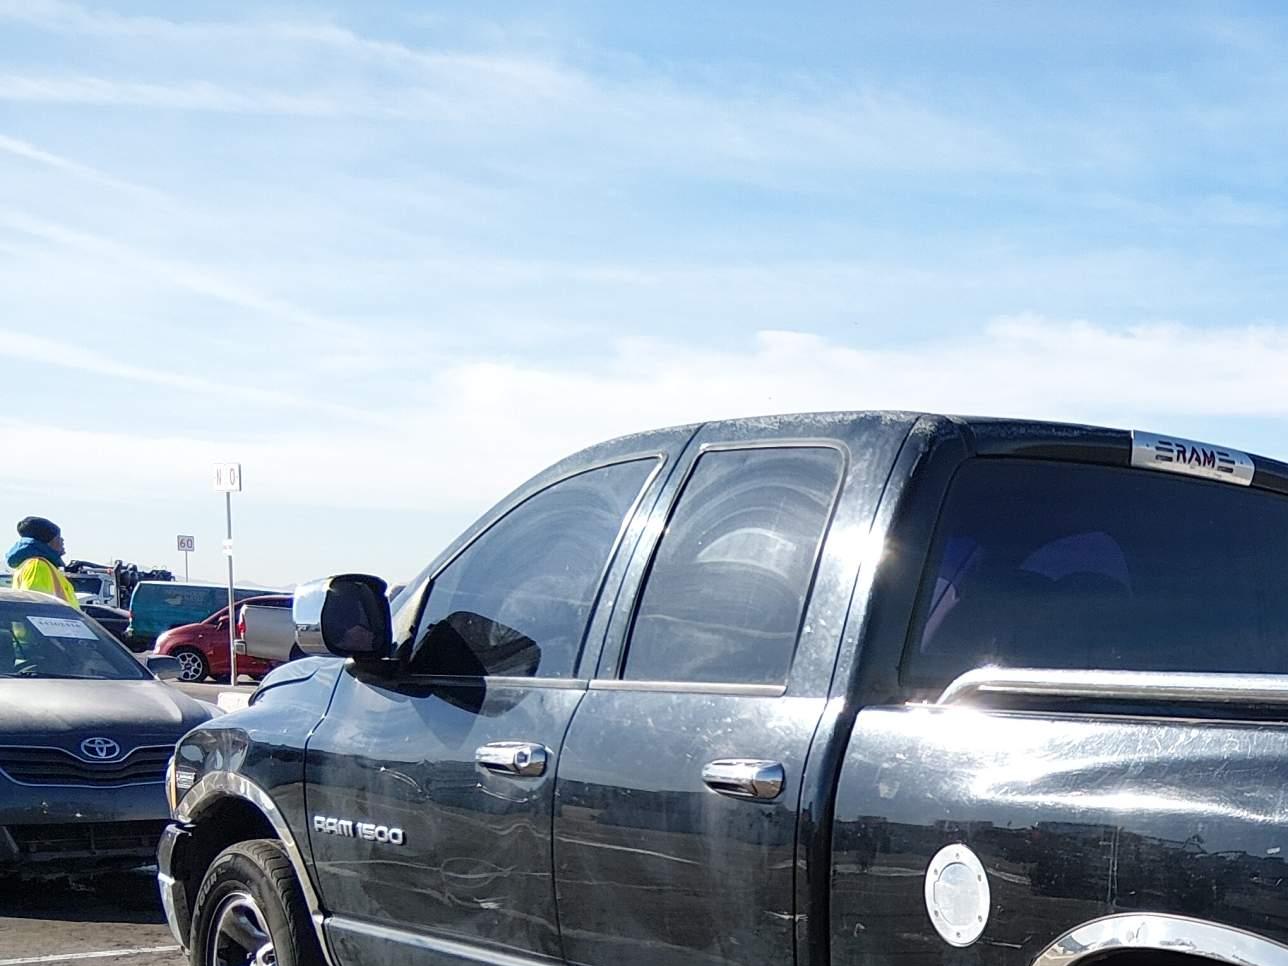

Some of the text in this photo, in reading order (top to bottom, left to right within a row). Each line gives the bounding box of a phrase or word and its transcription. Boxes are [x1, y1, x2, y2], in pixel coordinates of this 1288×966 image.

[1175, 443, 1217, 469] RAM
[179, 538, 192, 548] 60
[313, 815, 404, 846] RAM 1500
